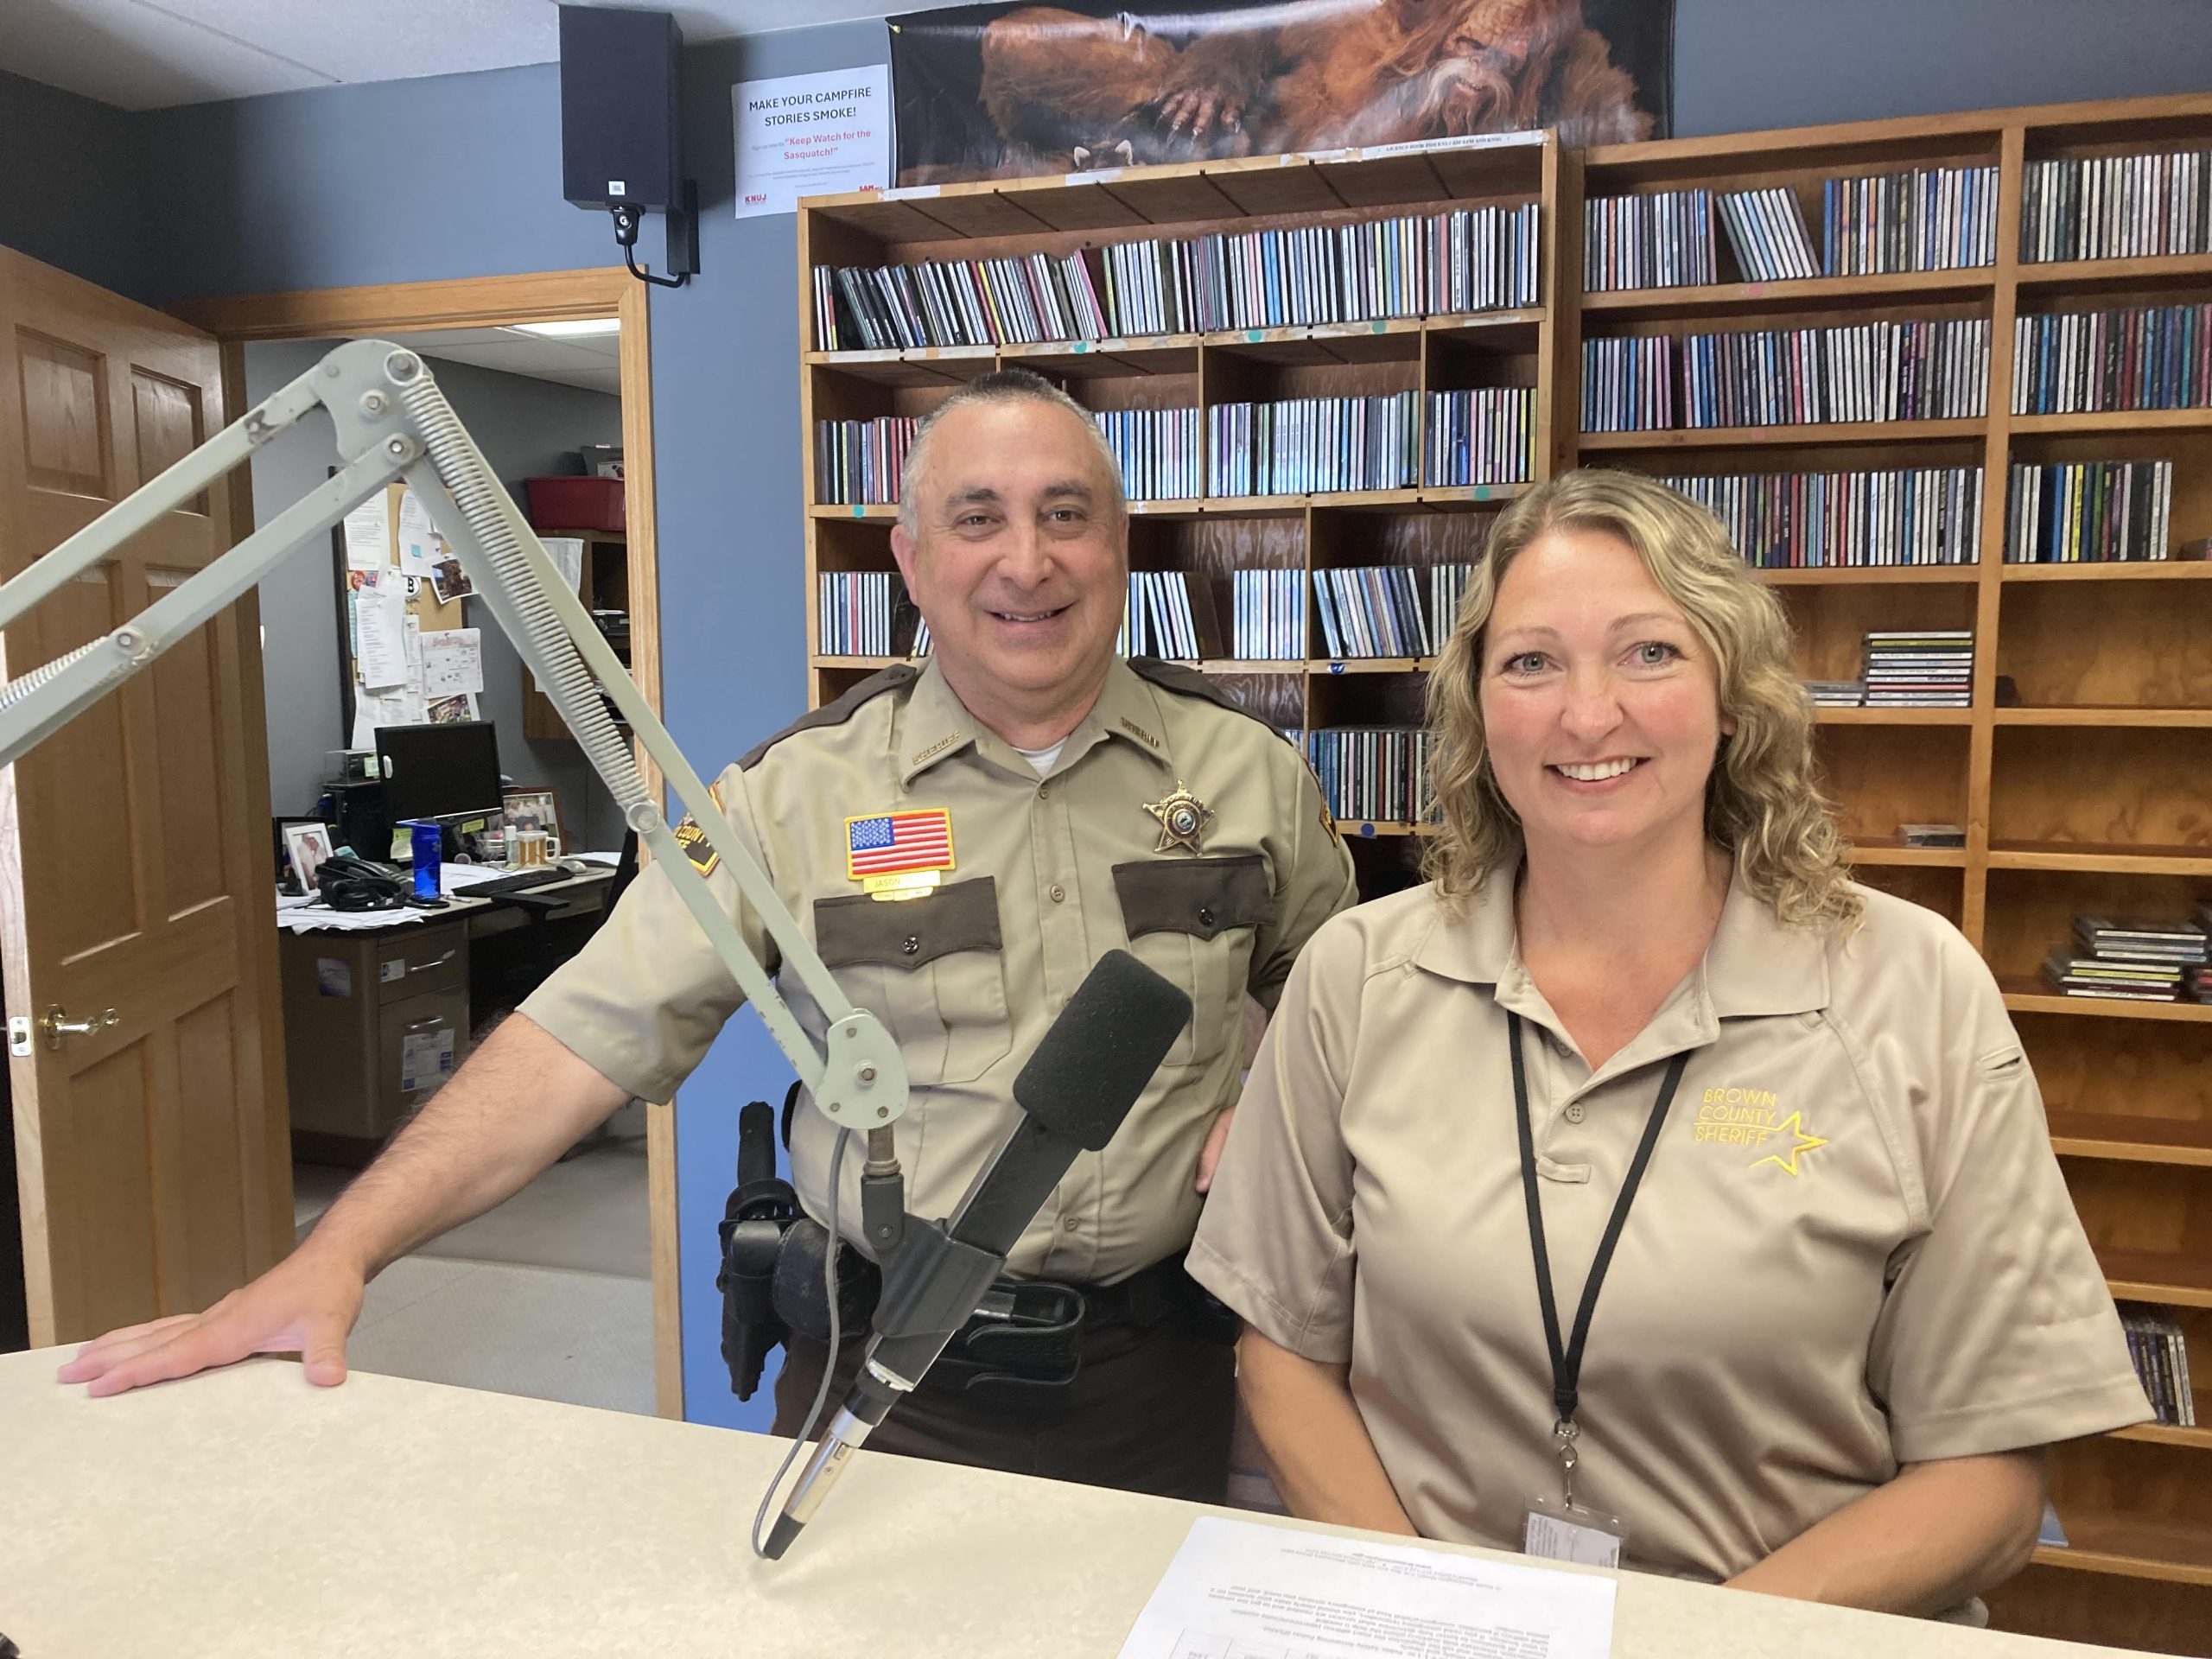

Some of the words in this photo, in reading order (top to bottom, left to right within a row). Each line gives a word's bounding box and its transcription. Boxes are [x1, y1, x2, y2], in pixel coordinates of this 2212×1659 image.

[749, 98, 779, 111] MAKE
[781, 94, 812, 106] YOUR
[816, 87, 872, 103] CAMPFIRE
[765, 112, 810, 126] STORIES
[813, 107, 856, 120] SMOKE!
[813, 133, 842, 143] Watch
[842, 130, 855, 139] for
[857, 130, 871, 138] the
[784, 147, 838, 160] Sasquatch!"
[745, 194, 766, 203] KNUJ
[874, 878, 900, 888] JASON
[1703, 1088, 1777, 1107] BROWN
[1699, 1106, 1777, 1124] COUNTY
[1694, 1127, 1768, 1147] SHERIFF
